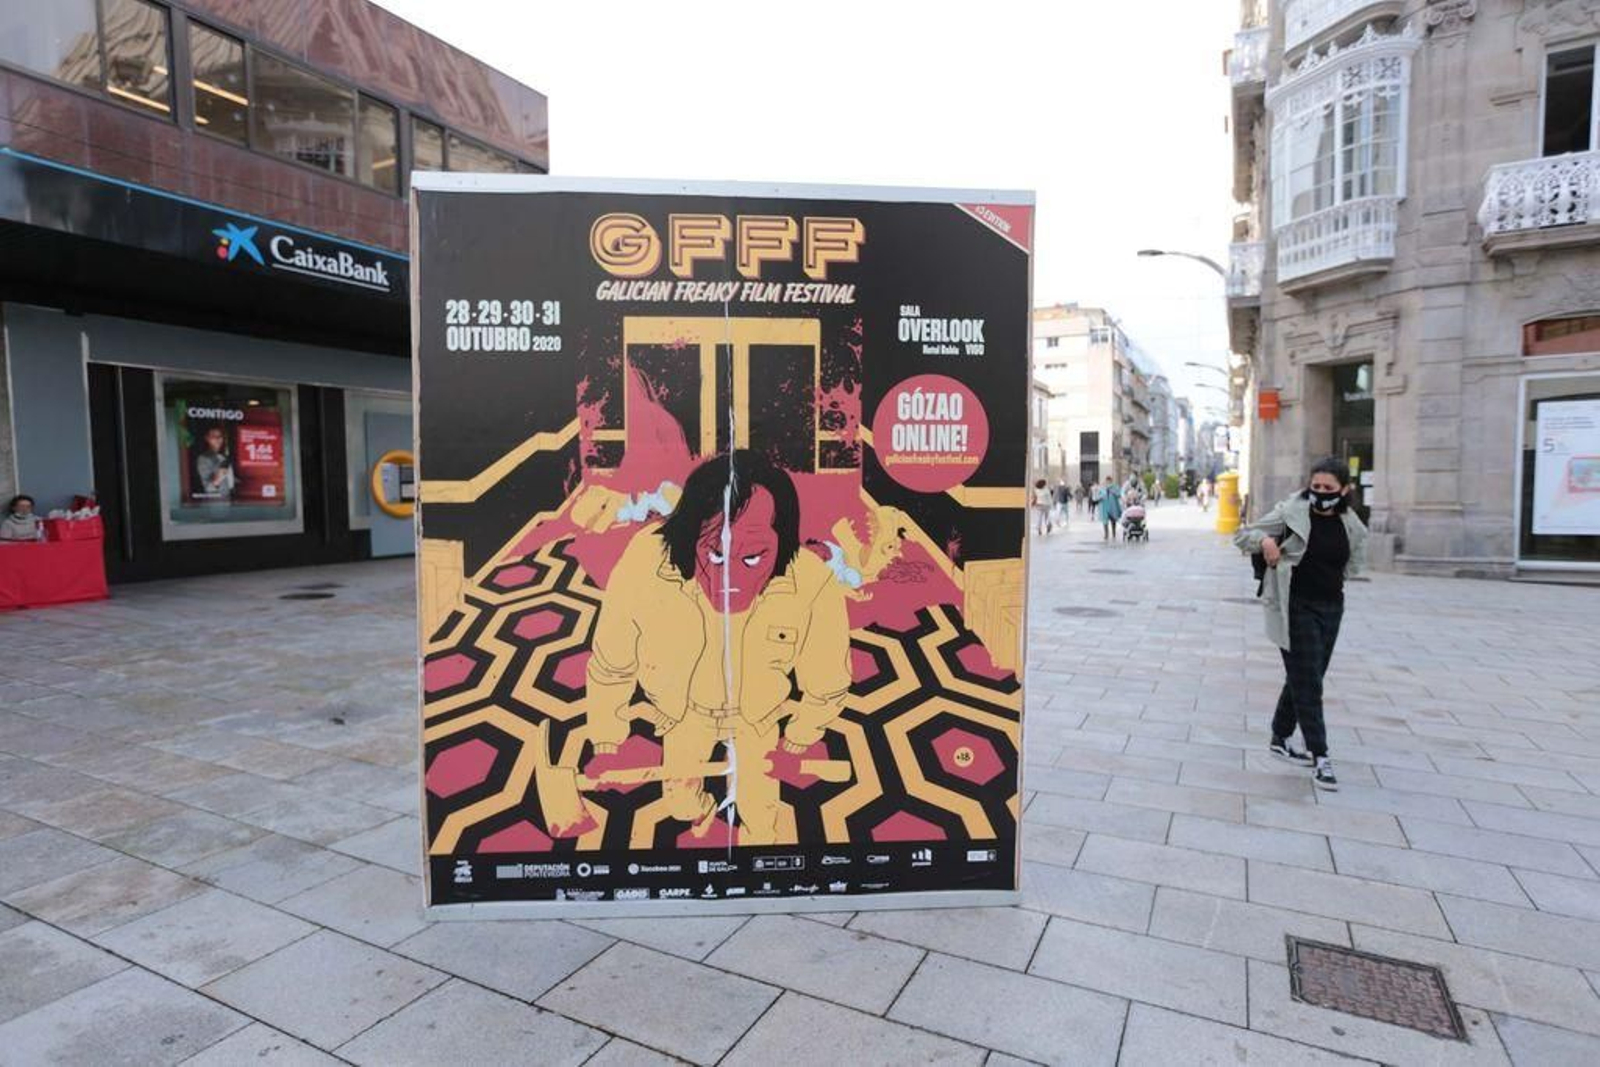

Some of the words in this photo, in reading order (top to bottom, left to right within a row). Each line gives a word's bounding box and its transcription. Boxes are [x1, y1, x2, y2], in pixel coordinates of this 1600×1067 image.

[589, 213, 865, 279] GFFF
[270, 235, 390, 286] CaixaBank
[596, 281, 676, 301] GALICIAN
[674, 281, 741, 302] FREAKY
[741, 282, 782, 303] FILM
[783, 283, 856, 304] FESTIVAL
[446, 326, 531, 352] OUTUBRO
[532, 335, 562, 352] 2020
[898, 318, 985, 343] OVERLOOK
[188, 407, 244, 420] CONTIGO
[897, 386, 963, 421] GÓZAO
[891, 423, 968, 452] ONLINE!
